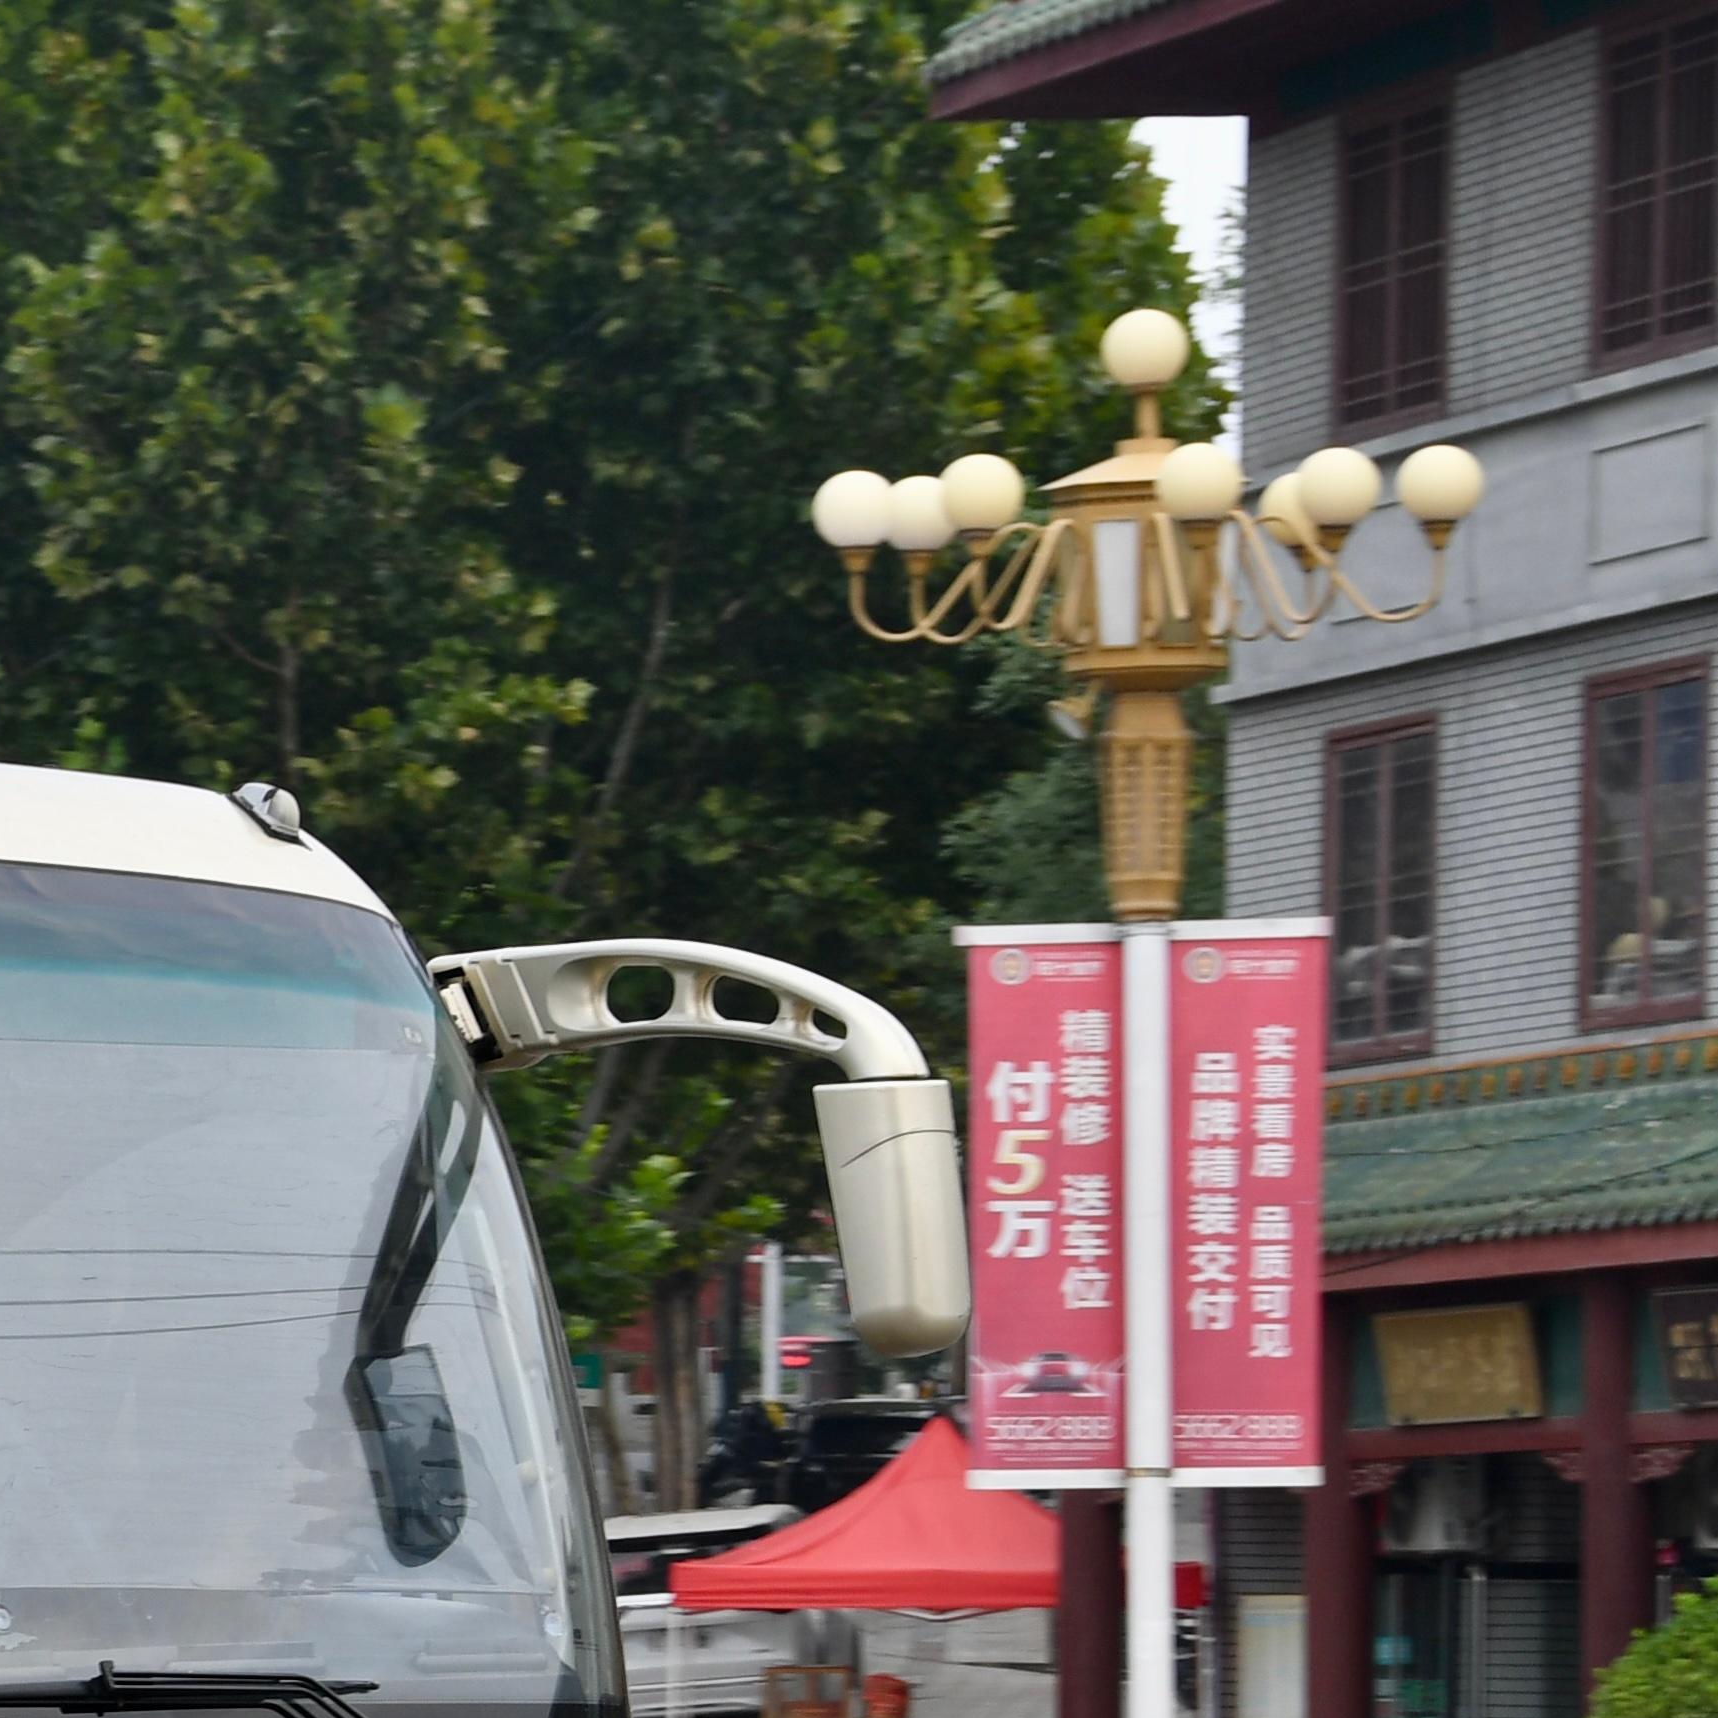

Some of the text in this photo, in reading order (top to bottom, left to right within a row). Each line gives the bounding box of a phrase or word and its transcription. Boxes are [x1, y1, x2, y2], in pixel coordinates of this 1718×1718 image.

[1058, 1009, 1110, 1146] 精装修
[1250, 1025, 1299, 1179] 实景看房
[985, 1061, 1054, 1260] 付5万
[1187, 1053, 1241, 1332] 品牌精装交付
[1058, 1175, 1110, 1311] 送车位
[1247, 1207, 1294, 1360] 品质可见
